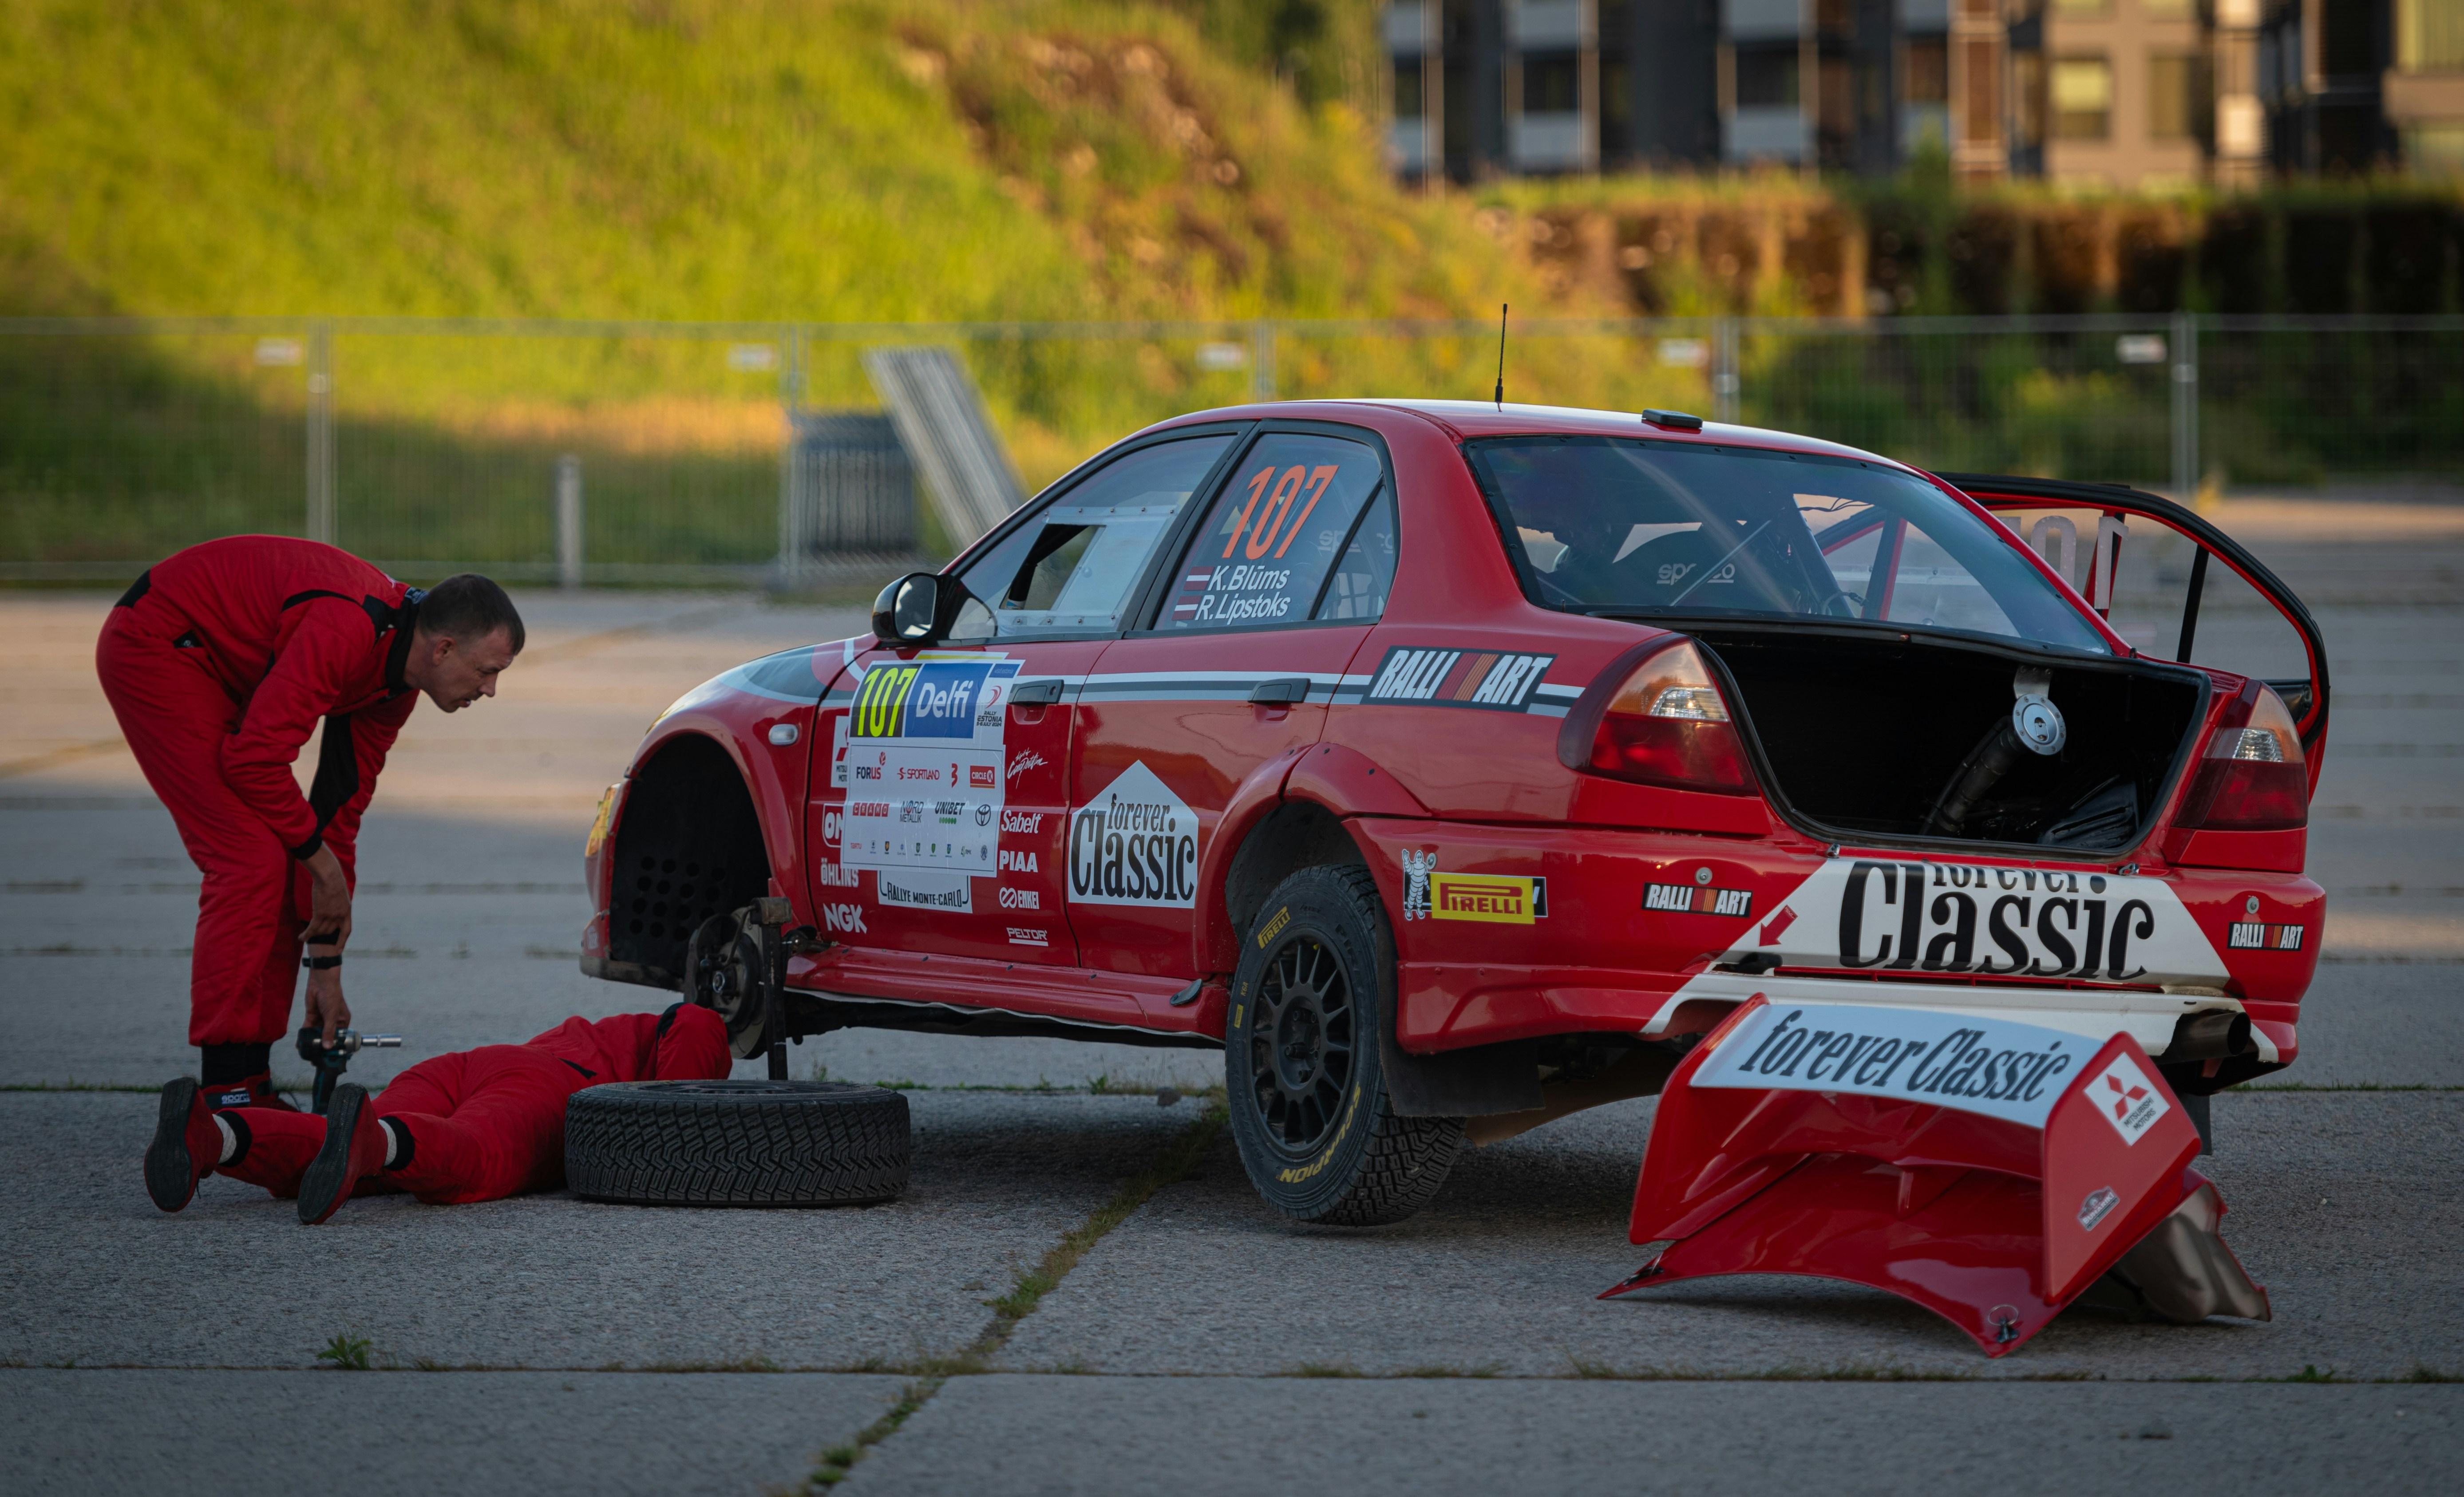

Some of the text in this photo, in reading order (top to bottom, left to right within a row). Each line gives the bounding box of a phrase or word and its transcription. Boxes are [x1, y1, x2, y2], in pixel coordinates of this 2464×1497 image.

[1222, 465, 1339, 560] 107
[1207, 565, 1290, 591] K.Blūms
[1195, 592, 1291, 625] R.Lipstoks
[1370, 650, 1553, 705] RALLI ART
[857, 668, 919, 737] 107
[916, 680, 973, 718] Delfi
[856, 766, 881, 780] FORUS
[907, 769, 940, 780] SPORTLAND
[972, 771, 986, 780] CIRCLE
[853, 806, 888, 814] CRAMO
[900, 814, 922, 823] METALLIK
[901, 800, 924, 814] NORD
[935, 801, 965, 815] UNIBET
[1107, 793, 1171, 832] forever
[1001, 810, 1040, 834] Sabelt
[999, 850, 1038, 873] PIAA
[1070, 808, 1195, 901] Classic
[887, 881, 962, 908] RALLYE MONTE-CARLO
[1017, 890, 1040, 909] ENKEI
[1440, 882, 1523, 915] PIRELLI
[1645, 884, 1752, 915] RALLI ART
[823, 903, 867, 934] NGK
[1258, 905, 1291, 949] PIRELLI
[1839, 861, 2155, 980] Classic
[1006, 927, 1047, 940] PELTOR
[2231, 923, 2304, 949] RALLI ART
[2124, 1097, 2155, 1128] MITSUBISHI
[2133, 1108, 2156, 1131] MOTORS
